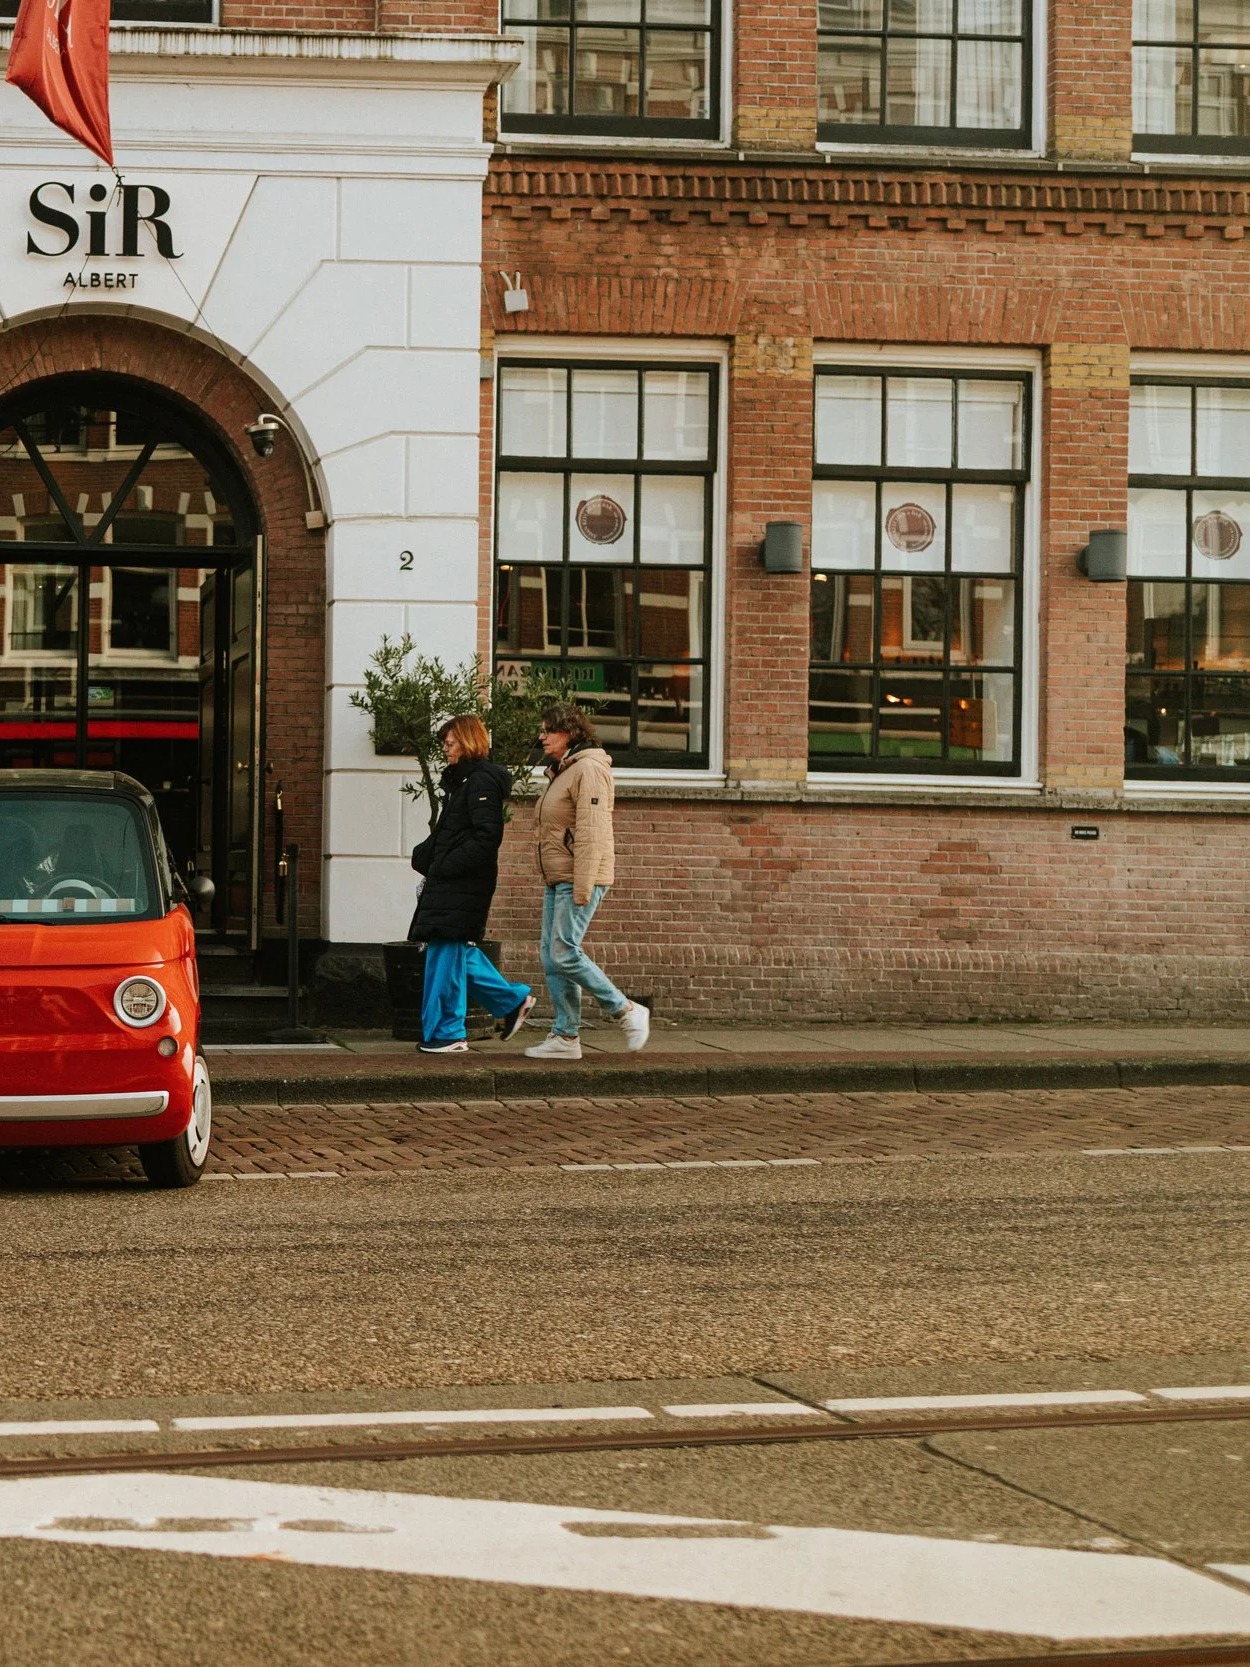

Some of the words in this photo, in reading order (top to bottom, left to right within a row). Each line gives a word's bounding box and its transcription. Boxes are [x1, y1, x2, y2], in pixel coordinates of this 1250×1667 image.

[26, 181, 185, 260] SiR
[63, 272, 139, 289] ALBERT
[399, 550, 414, 571] 2
